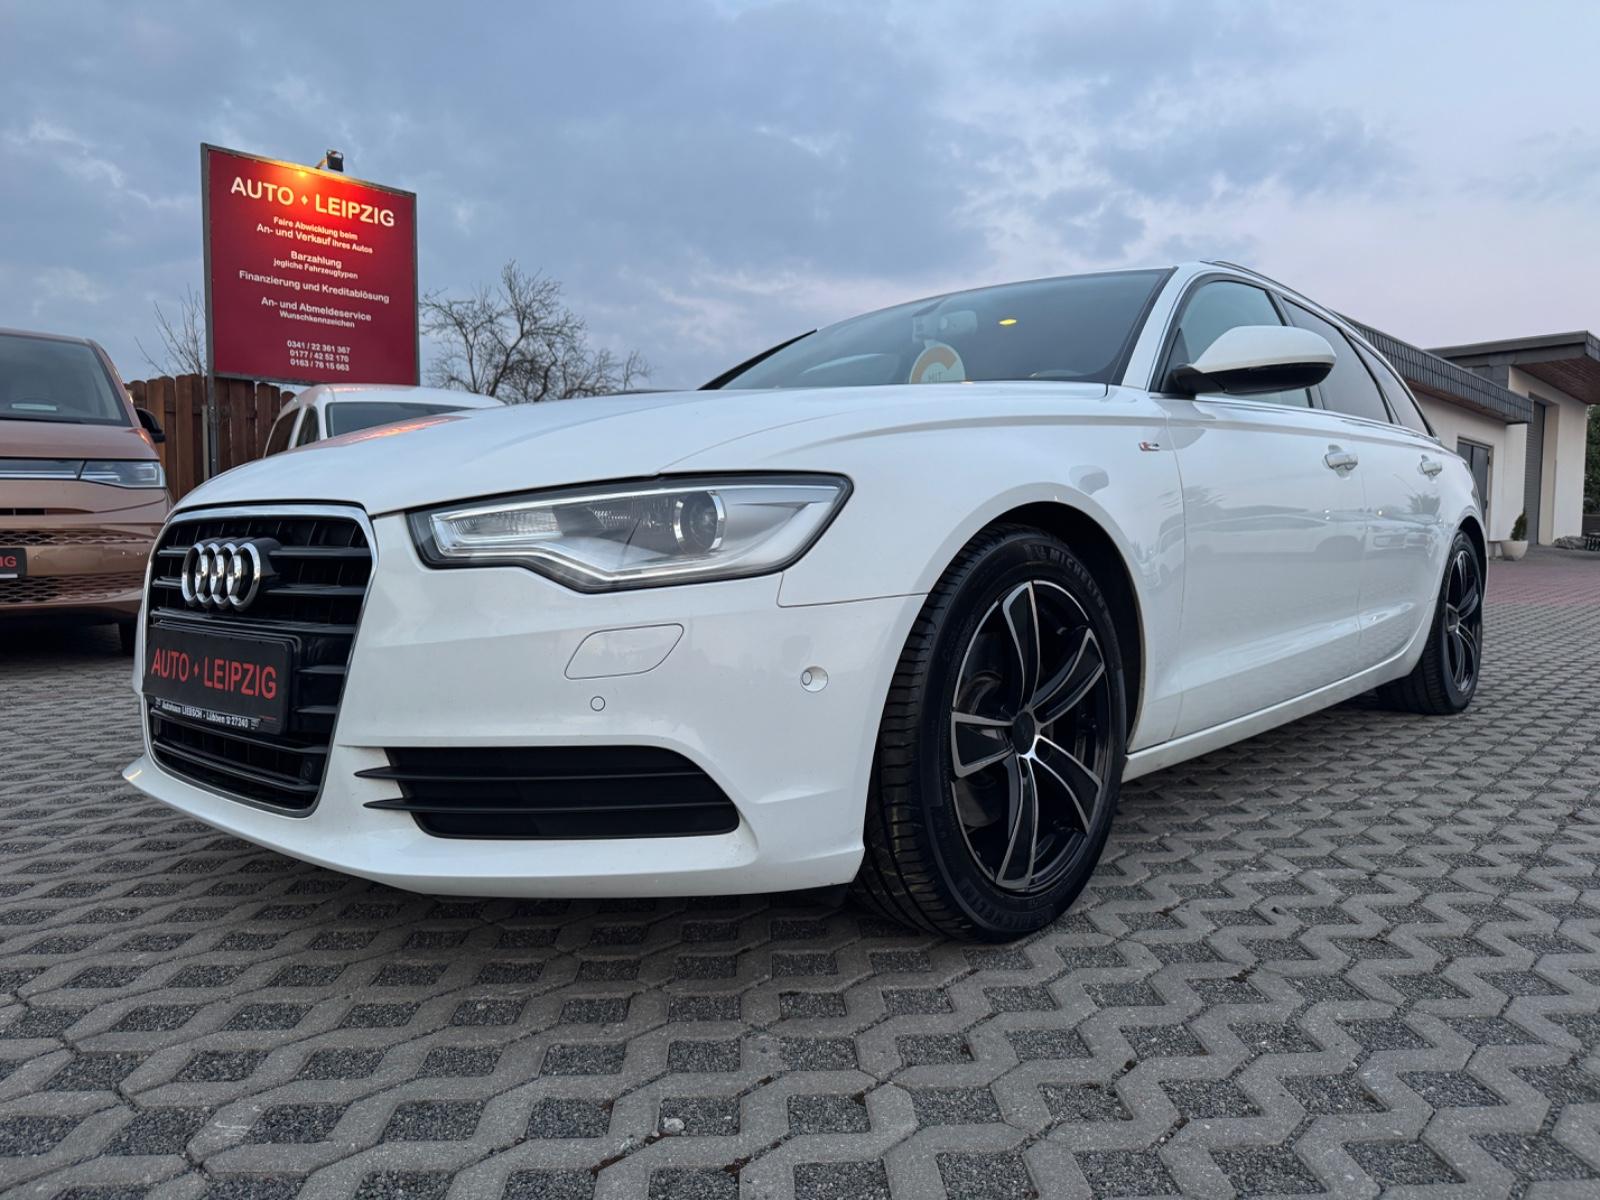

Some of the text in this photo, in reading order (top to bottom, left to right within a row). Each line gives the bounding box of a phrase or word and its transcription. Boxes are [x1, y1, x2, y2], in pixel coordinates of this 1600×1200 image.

[231, 176, 395, 227] AUTO LEIPZIG
[256, 223, 373, 254] An- und Verkauf Ihres Autos
[273, 216, 358, 240] Faire Abwicklung beim
[273, 258, 358, 280] jegliche Fahrzeugtypen
[290, 250, 342, 269] Barzahlung
[239, 270, 390, 304] Finanzierung und Kreditablösung
[261, 297, 371, 321] An- und Abmeldeservice
[279, 310, 355, 328] Wunschkennzeichen
[287, 340, 306, 349] 0341
[289, 349, 308, 358] 0177
[313, 352, 324, 360] 42
[1049, 548, 1104, 608] MICHELIN
[151, 648, 277, 699] AUTO LEIPZIG
